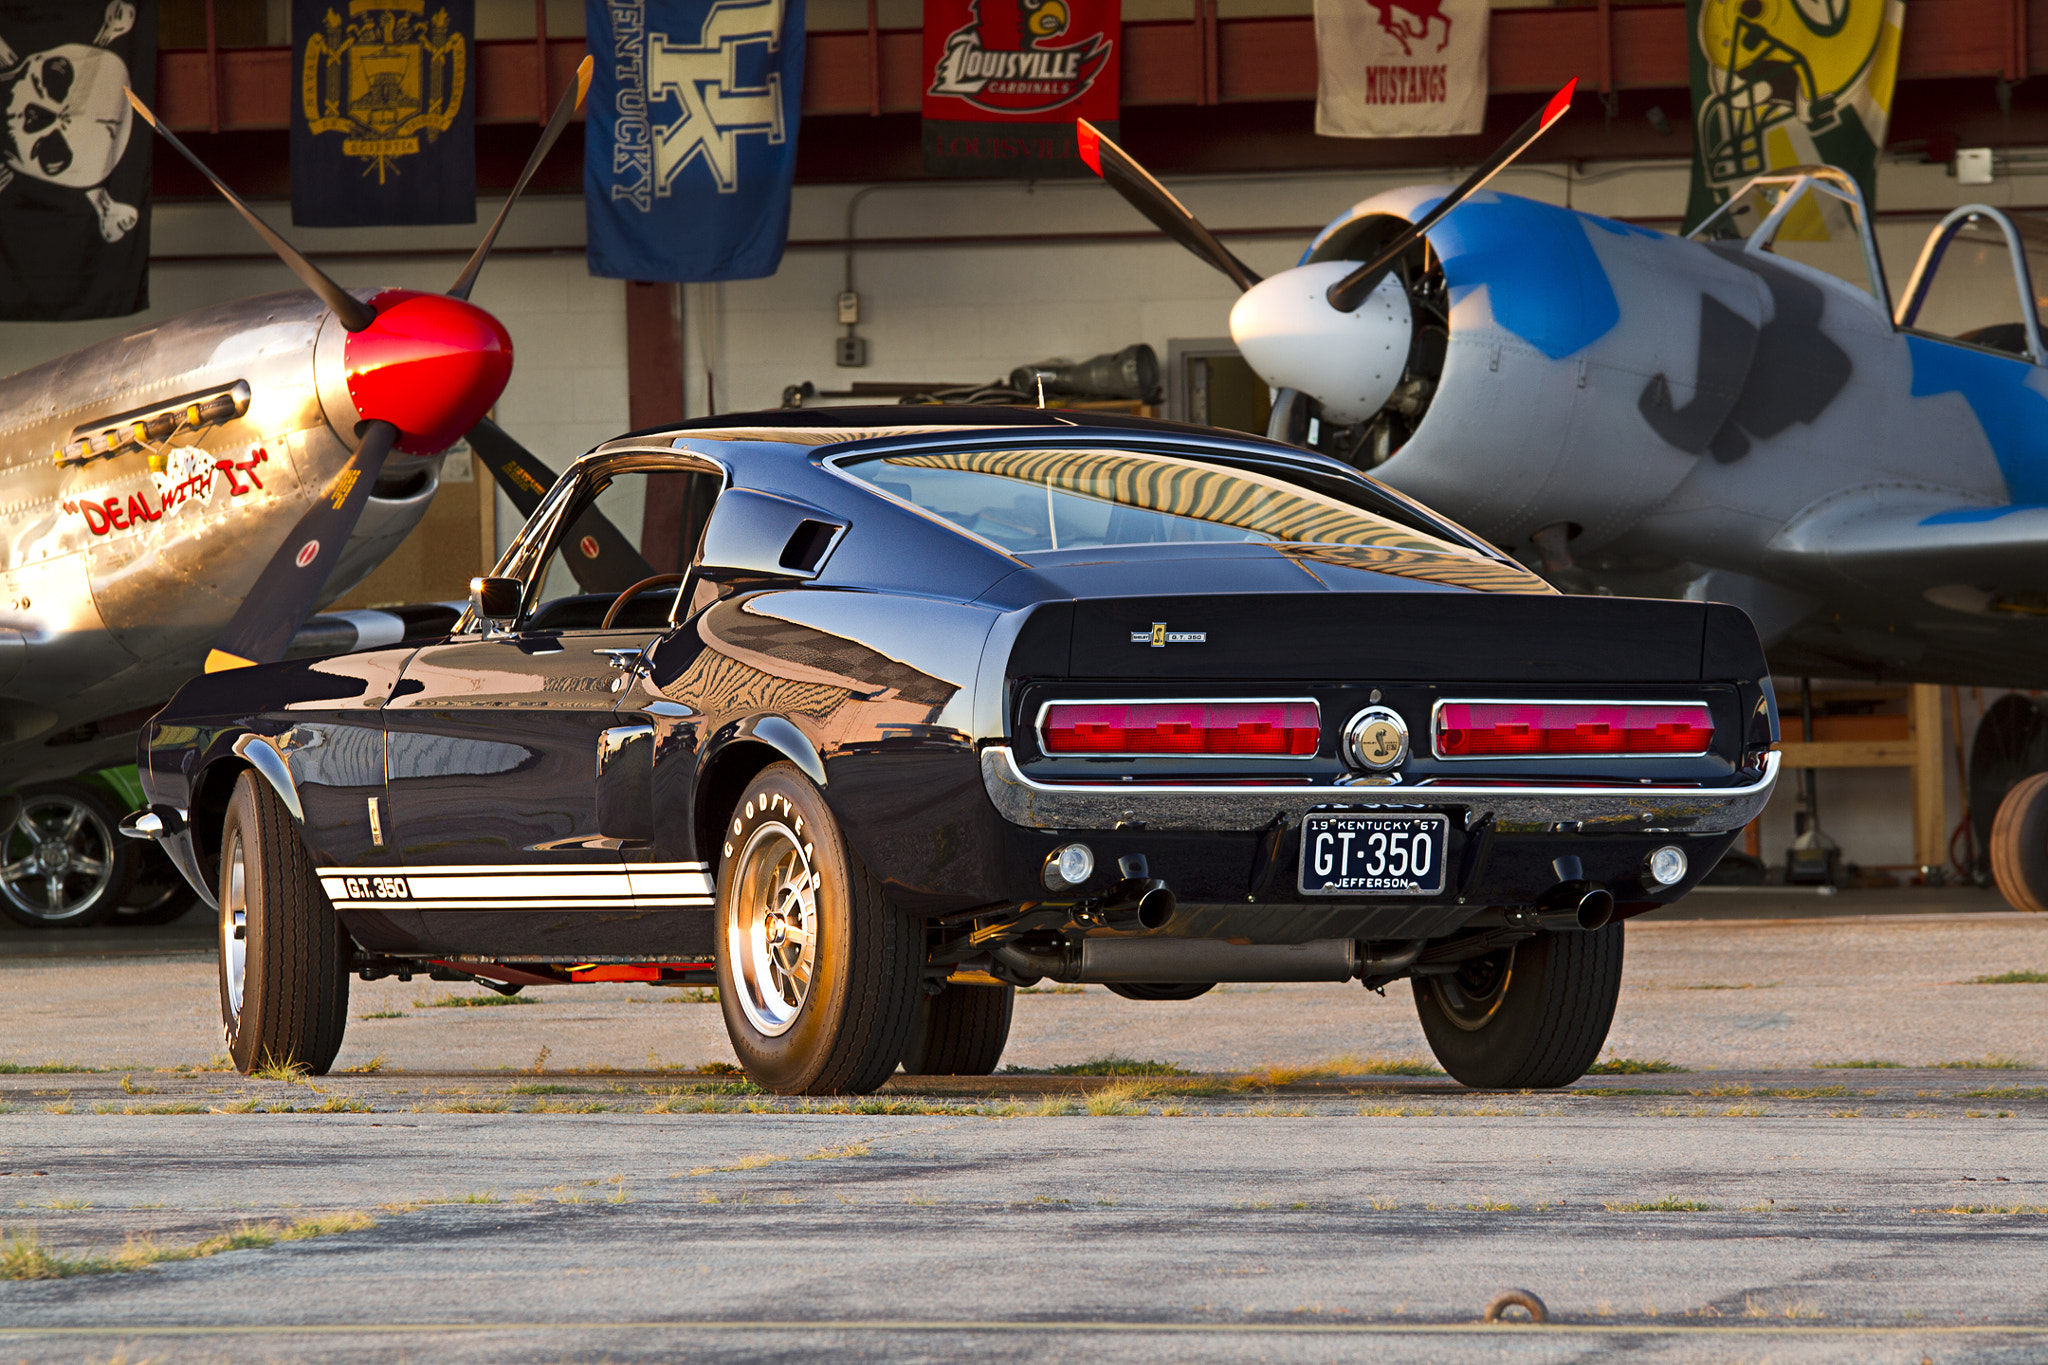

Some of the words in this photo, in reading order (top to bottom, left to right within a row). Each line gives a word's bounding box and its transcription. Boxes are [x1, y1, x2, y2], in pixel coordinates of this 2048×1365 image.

[988, 82, 1070, 94] CARDINALS
[1365, 64, 1447, 105] MUSTANGS
[608, 0, 652, 213] ENTUCKY
[1311, 821, 1329, 830] 19
[1337, 821, 1411, 831] KENTUCKY
[1420, 821, 1439, 831] 67
[1334, 878, 1409, 888] JEFFERSON
